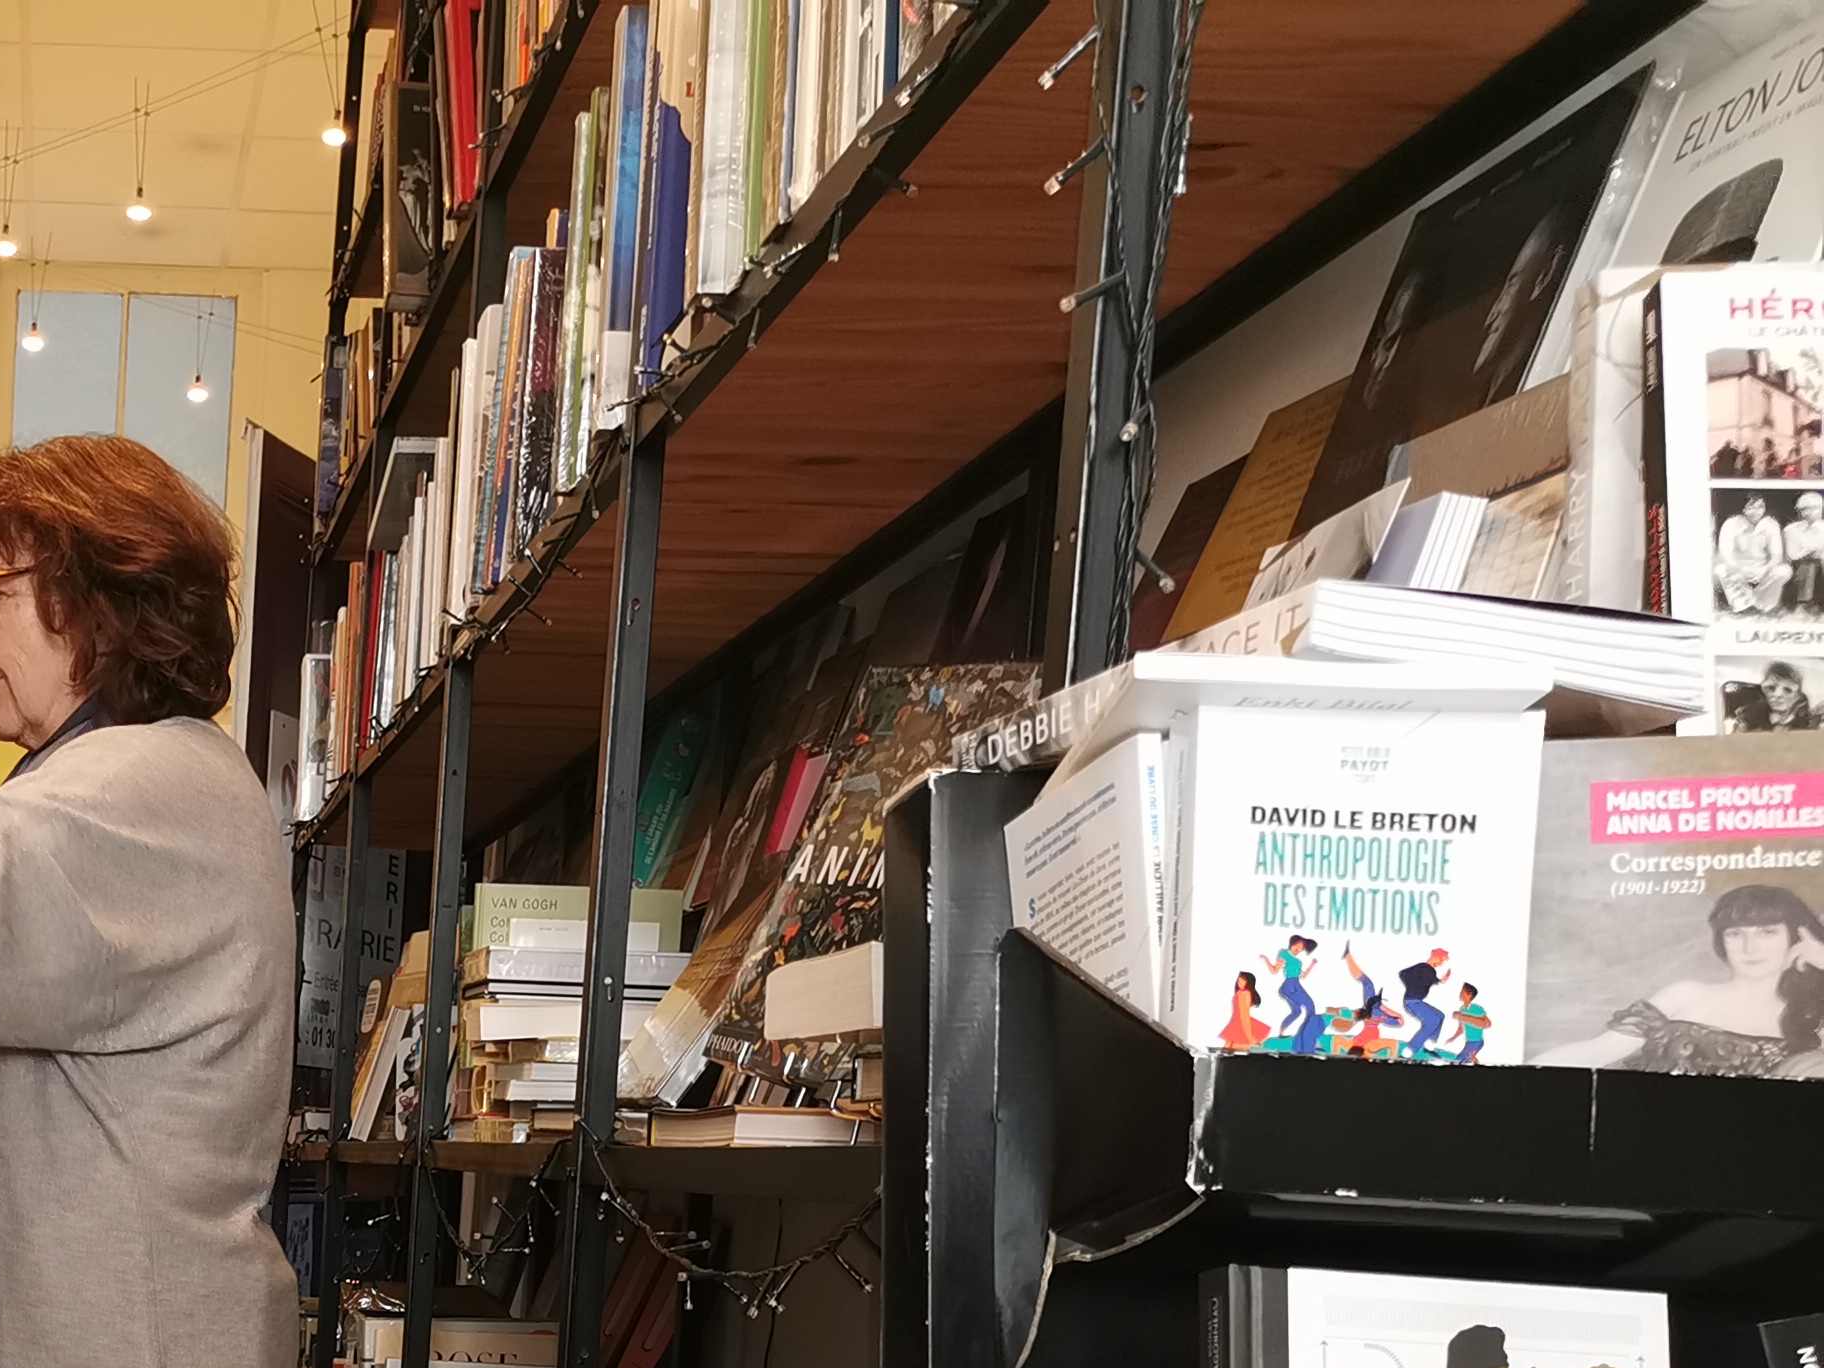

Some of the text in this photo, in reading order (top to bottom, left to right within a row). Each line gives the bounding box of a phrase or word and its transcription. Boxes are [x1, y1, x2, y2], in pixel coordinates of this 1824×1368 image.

[1674, 71, 1782, 163] ELTON
[987, 701, 1072, 765] DEBBIE
[1606, 783, 1797, 812] MARCEL PROUST
[1250, 805, 1477, 833] DAVID LE BRETON
[1606, 806, 1824, 835] ANNA DE NOAILLES
[1254, 831, 1453, 885] ANTHROPOLOGIE
[1609, 844, 1824, 877] Correspondance
[1610, 879, 1707, 898] (1901-1922)
[490, 896, 559, 912] VAN GOGH
[1263, 881, 1440, 937] DES ÉMOTIONS
[706, 1033, 746, 1055] PHAIDO
